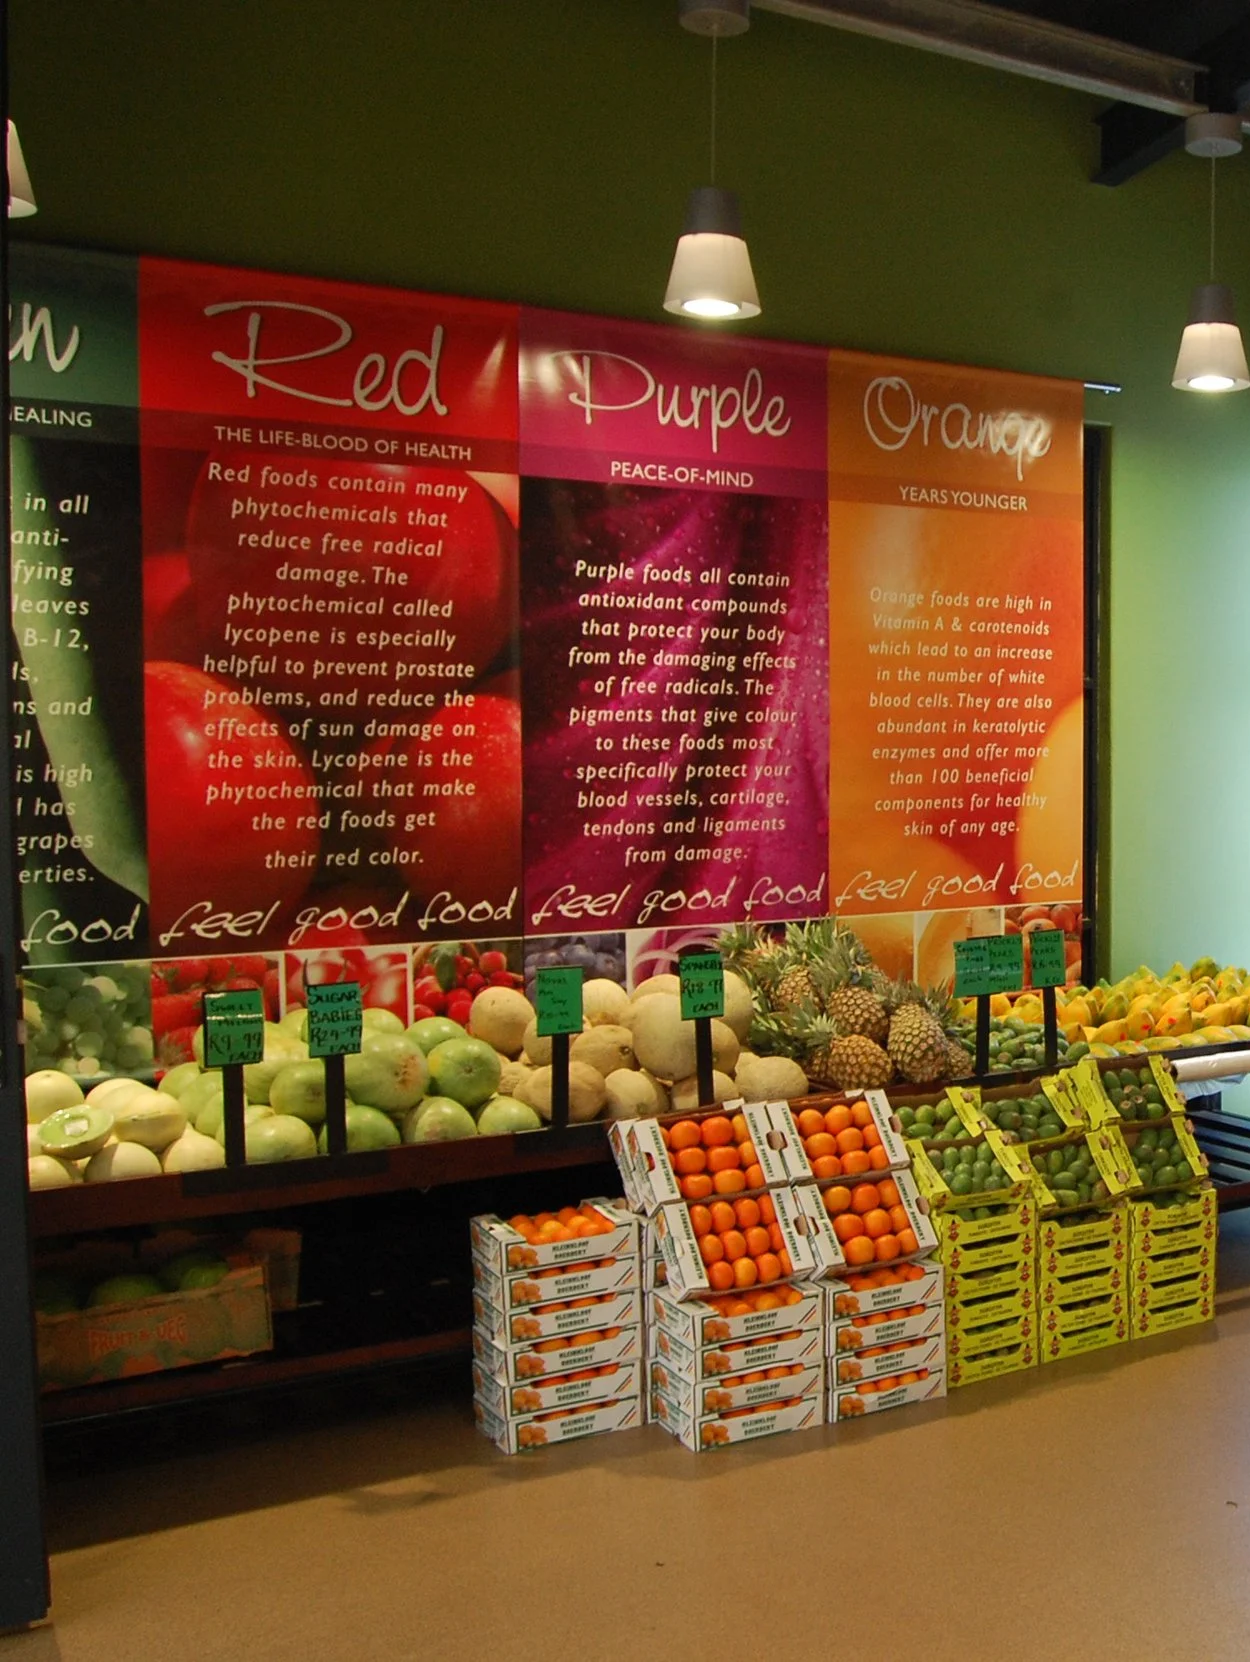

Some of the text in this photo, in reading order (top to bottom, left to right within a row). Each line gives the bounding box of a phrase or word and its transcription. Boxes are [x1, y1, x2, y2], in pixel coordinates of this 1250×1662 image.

[204, 301, 449, 417] Red
[550, 350, 791, 453] Purple
[9, 406, 93, 428] EALING
[864, 376, 1051, 481] Orange
[214, 425, 471, 460] THE LIFE-BLOOD OF HEALTH
[208, 462, 467, 502] Red foods contain many
[611, 461, 752, 487] PEACE-OF-MIND
[899, 486, 1027, 510] YEARS YOUNGER
[231, 496, 447, 527] phytochemicals that
[238, 530, 442, 556] reduce free radical
[276, 562, 407, 587] damage. The
[575, 559, 789, 586] Purple foods all contain
[227, 592, 452, 617] phytochemical called
[578, 591, 786, 615] antioxidant compounds
[224, 623, 455, 651] lycopene is especially
[582, 618, 784, 644] that protect your body
[568, 646, 795, 671] from the damaging effects
[868, 640, 1052, 659] which lead to an increase
[203, 654, 474, 680] helpful to prevent prostate
[48, 696, 92, 715] and
[204, 686, 474, 708] problems, and reduce the
[869, 692, 1052, 712] blood cells. They are also
[569, 705, 796, 726] pigments that give colour
[877, 718, 1045, 736] abundant in keratolytic
[204, 718, 474, 741] effects of sun damage on
[208, 748, 472, 771] the skin. Lycopene is the
[576, 761, 789, 783] specifically protect your
[44, 764, 92, 788] high
[890, 767, 1033, 785] than 100 beneficial
[35, 797, 76, 816] has
[577, 790, 627, 807] blood
[636, 789, 702, 806] vessels,
[875, 792, 1045, 813] components for healthy
[625, 846, 665, 866] from
[836, 859, 1077, 907] feel good food
[532, 872, 829, 927] feel good food
[20, 904, 141, 952] food
[159, 887, 518, 947] feel good food
